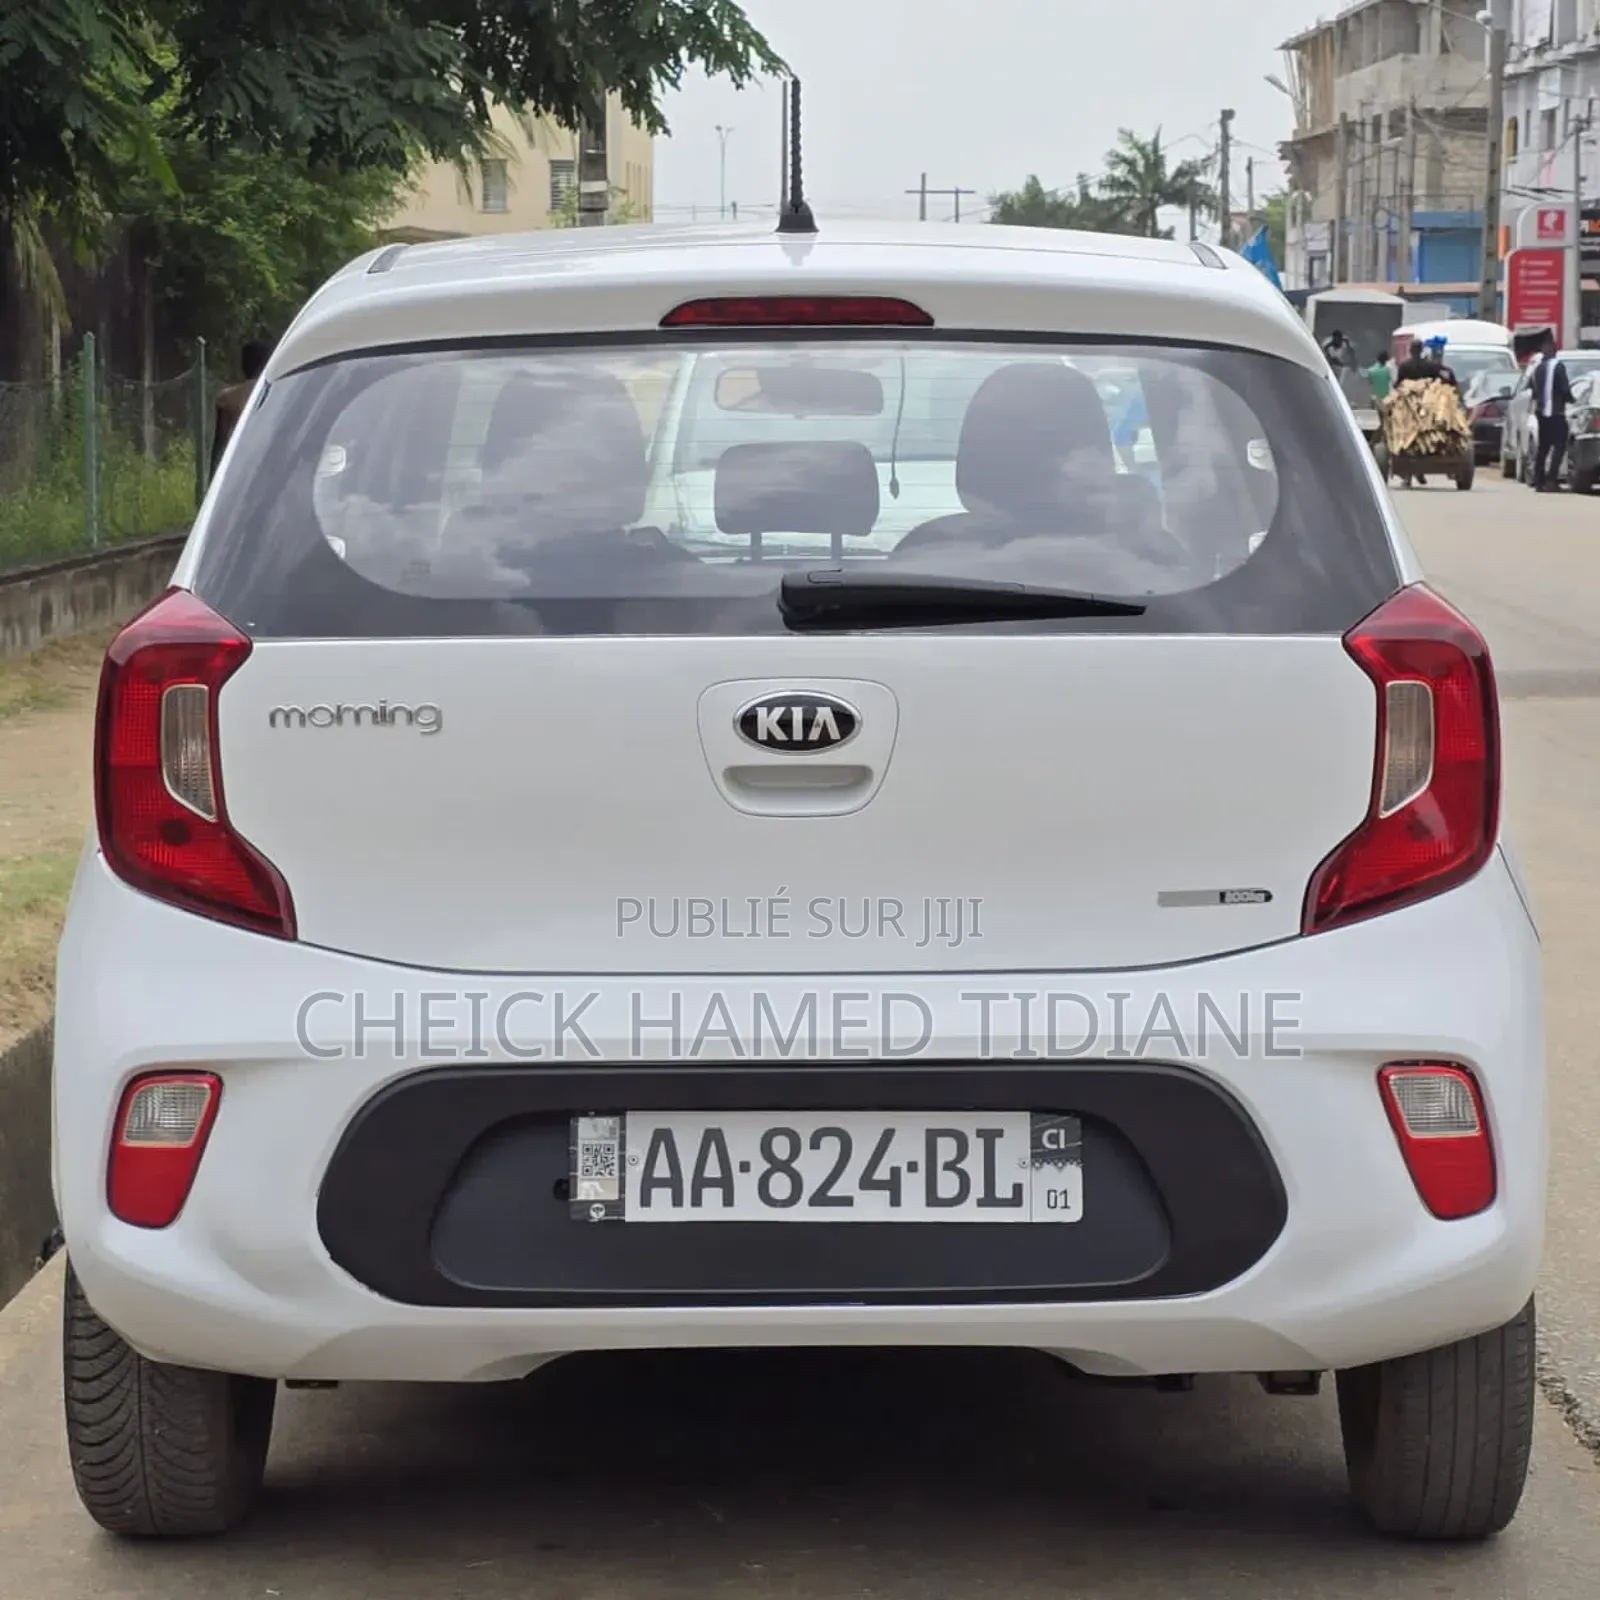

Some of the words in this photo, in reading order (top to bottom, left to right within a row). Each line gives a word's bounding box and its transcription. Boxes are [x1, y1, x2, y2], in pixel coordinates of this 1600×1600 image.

[269, 698, 442, 734] morning
[756, 706, 841, 741] KIA
[1042, 1128, 1066, 1150] CI
[1046, 1187, 1072, 1210] 01
